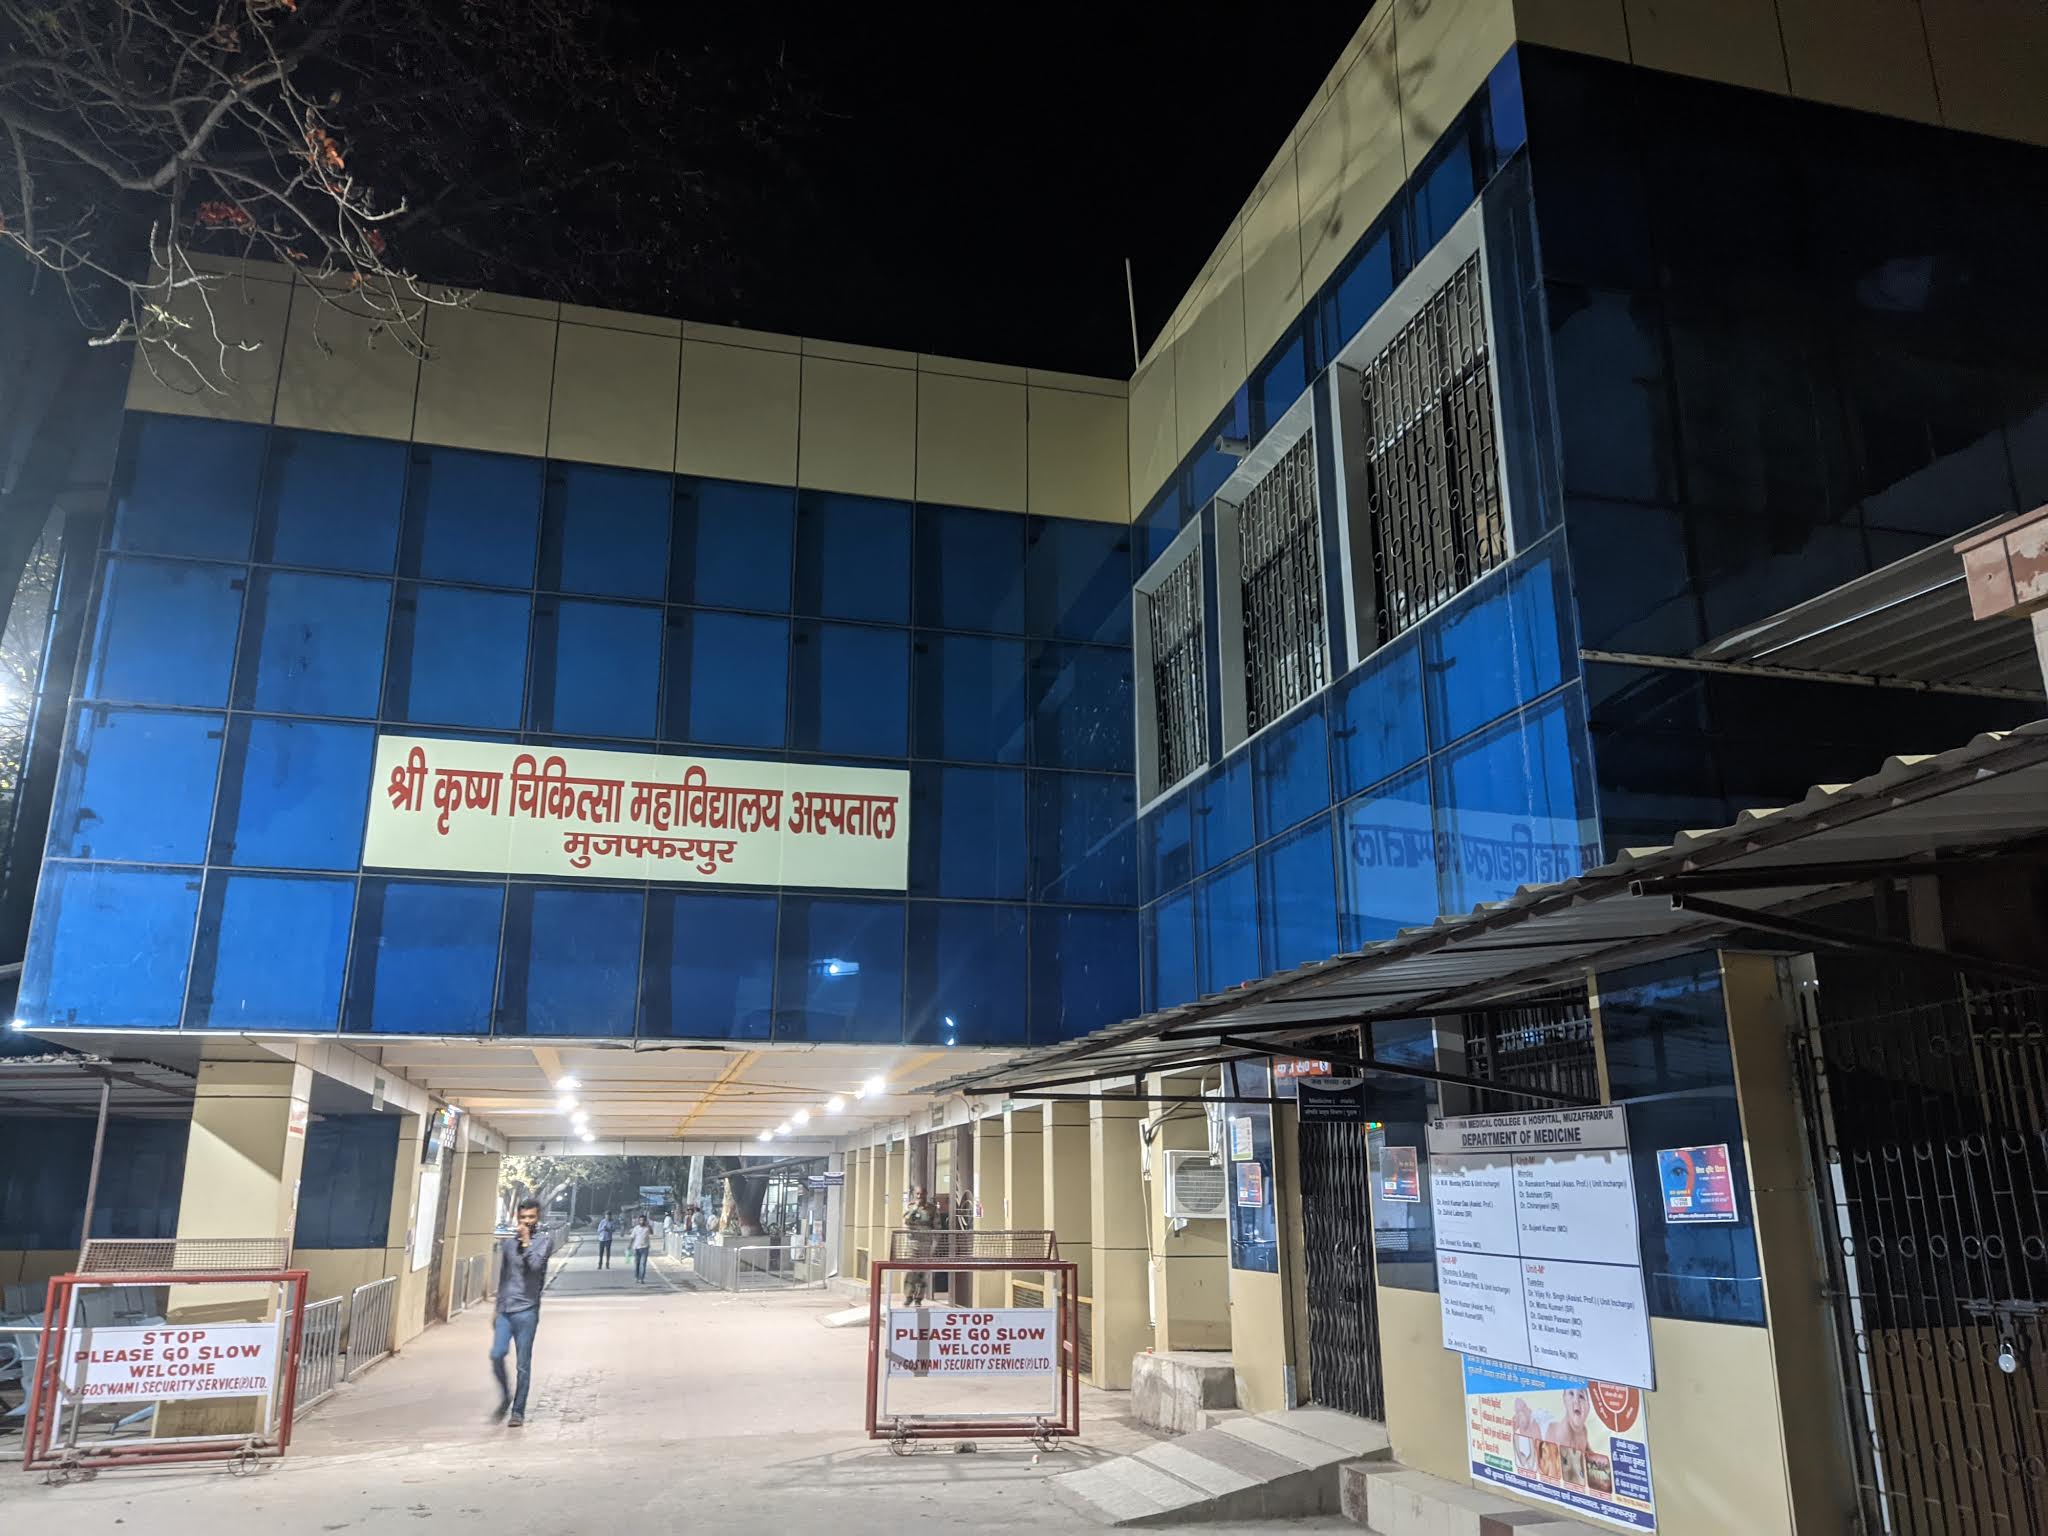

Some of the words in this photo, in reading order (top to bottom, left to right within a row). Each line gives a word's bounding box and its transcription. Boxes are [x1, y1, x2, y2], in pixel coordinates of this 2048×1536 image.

[387, 746, 429, 812] श्री
[433, 768, 504, 836] कृष्ण
[508, 753, 625, 824] चिकित्सा
[630, 765, 784, 833] महाविद्यालय
[788, 792, 899, 840] अस्पताल
[563, 832, 738, 875] मुजफ्फरपुर
[1468, 1119, 1492, 1129] MEDICAL
[1493, 1117, 1521, 1127] COLLEGE
[1523, 1117, 1527, 1125] &
[1529, 1114, 1562, 1125] HOSPITAL,
[1563, 1109, 1614, 1123] MUZAFFARPUR
[1462, 1131, 1517, 1146] DEPARTMENT
[1519, 1130, 1532, 1145] OF
[1534, 1127, 1582, 1144] MEDICINE
[945, 1314, 994, 1326] STOP
[142, 1330, 207, 1345] STOP
[896, 1328, 961, 1341] PLEASE
[967, 1328, 990, 1341] GO
[996, 1328, 1045, 1340] SLOW
[74, 1348, 154, 1363] PLEASE
[162, 1346, 189, 1360] GO
[198, 1344, 262, 1359] SLOW
[939, 1343, 1011, 1356] WELCOME
[129, 1362, 216, 1378] WELCOME
[944, 1358, 985, 1370] SECURITY
[81, 1381, 139, 1396] GOSWAMI
[142, 1380, 195, 1394] SECURITY
